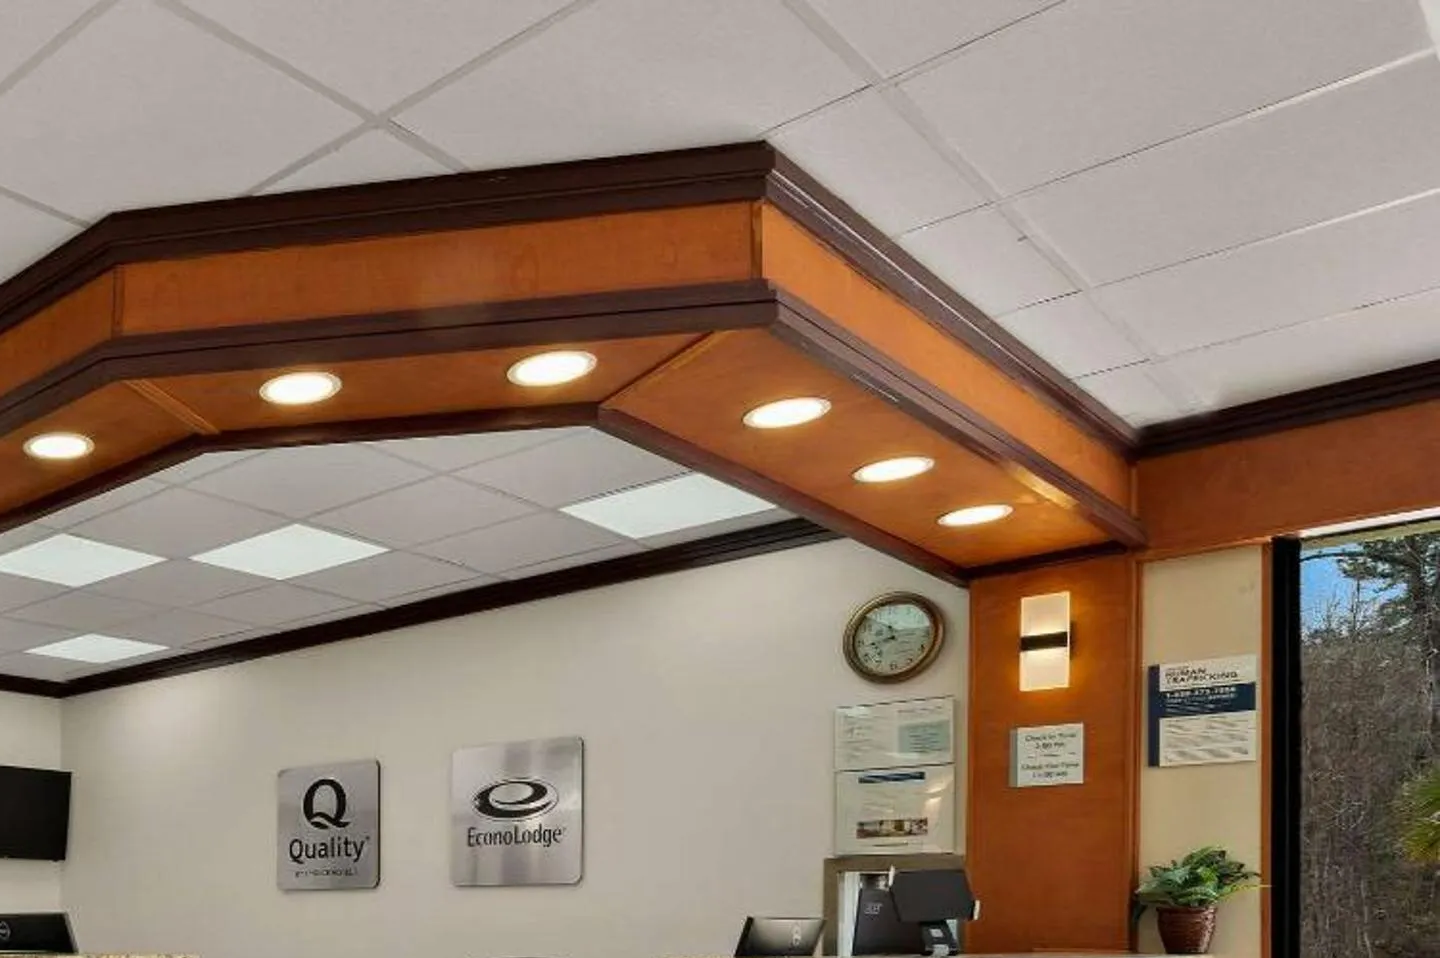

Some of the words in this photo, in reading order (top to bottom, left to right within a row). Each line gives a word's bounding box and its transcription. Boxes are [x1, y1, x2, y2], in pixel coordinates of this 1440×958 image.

[303, 779, 351, 830] Q
[467, 823, 563, 848] EconoLodge
[289, 836, 366, 865] Quality
